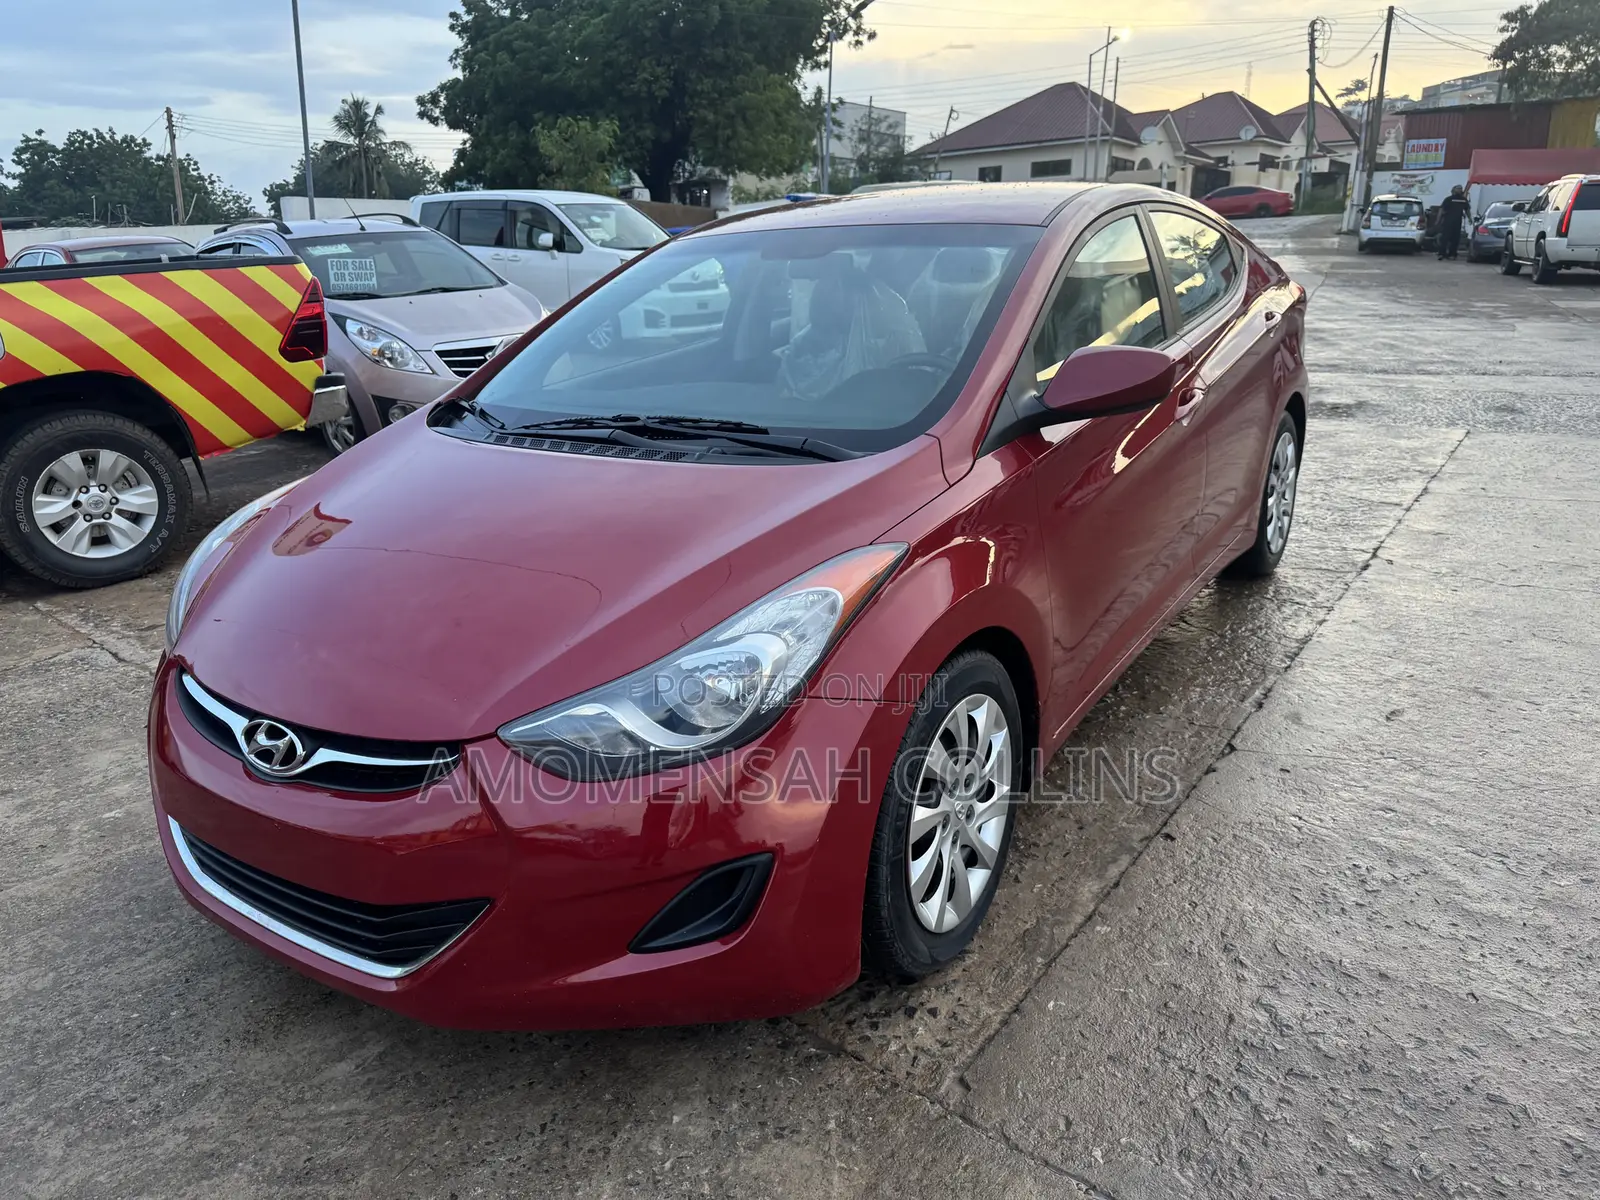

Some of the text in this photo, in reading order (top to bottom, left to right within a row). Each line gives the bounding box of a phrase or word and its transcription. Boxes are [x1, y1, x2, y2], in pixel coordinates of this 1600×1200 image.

[1406, 143, 1445, 153] LAUNDRY
[330, 260, 374, 271] FOR SALE
[333, 272, 375, 282] OR SWAP
[15, 475, 31, 533] SAILUN
[143, 450, 177, 553] TERRAMAX A/T
